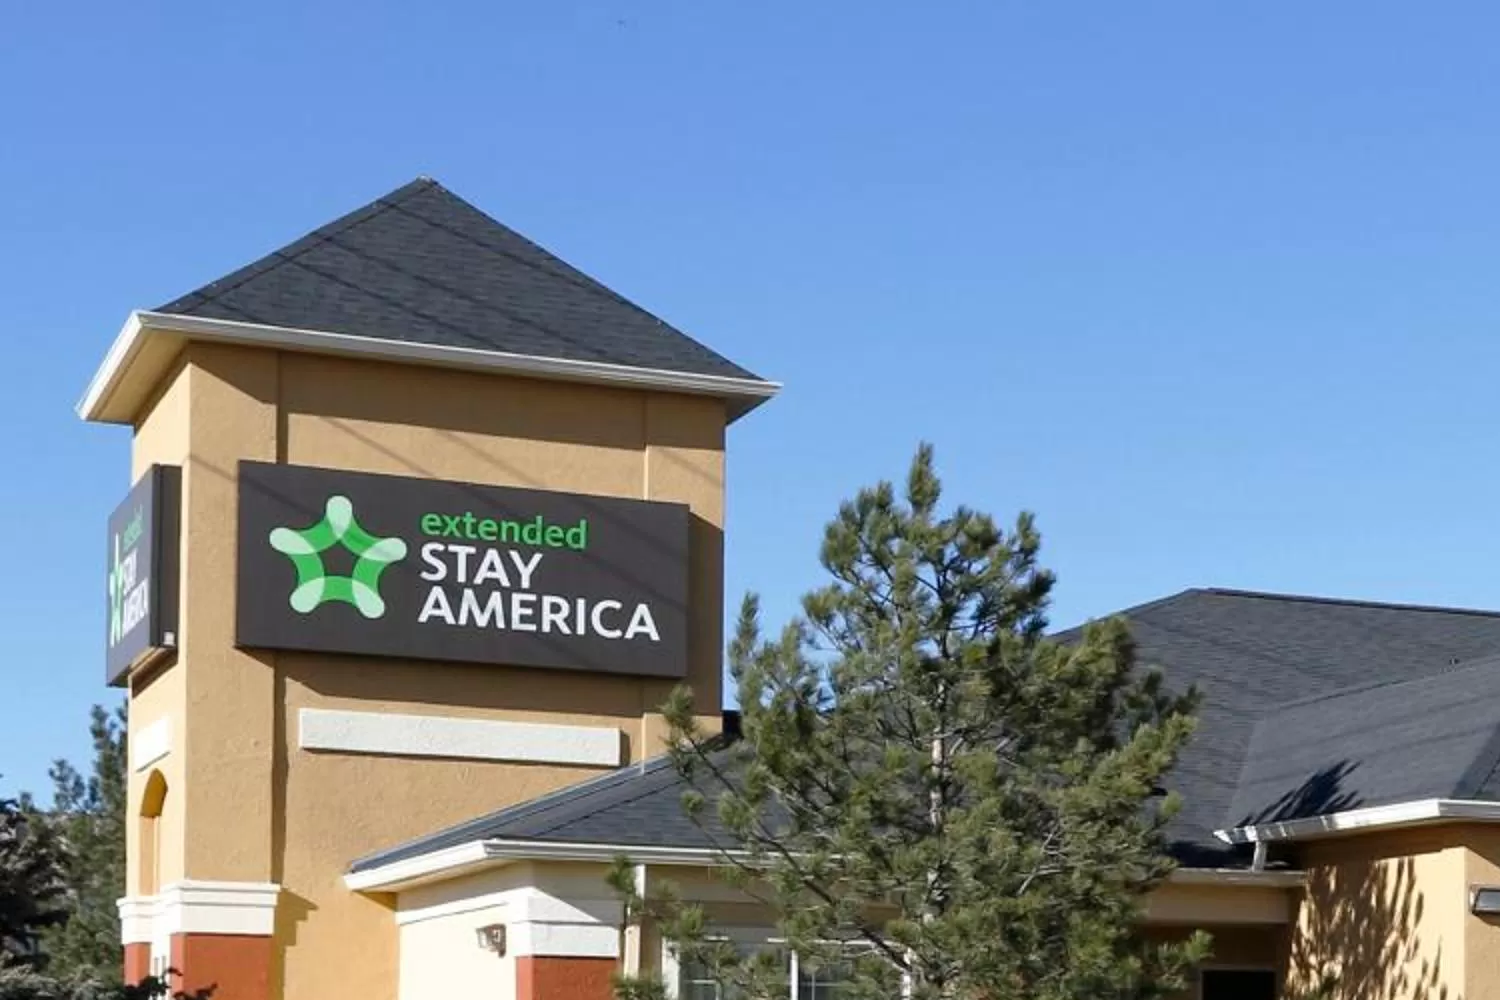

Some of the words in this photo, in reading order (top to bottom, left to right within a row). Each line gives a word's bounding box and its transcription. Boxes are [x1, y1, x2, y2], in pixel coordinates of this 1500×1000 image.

[421, 511, 587, 549] extended
[420, 542, 543, 589] STAY
[418, 585, 661, 641] AMERICA
